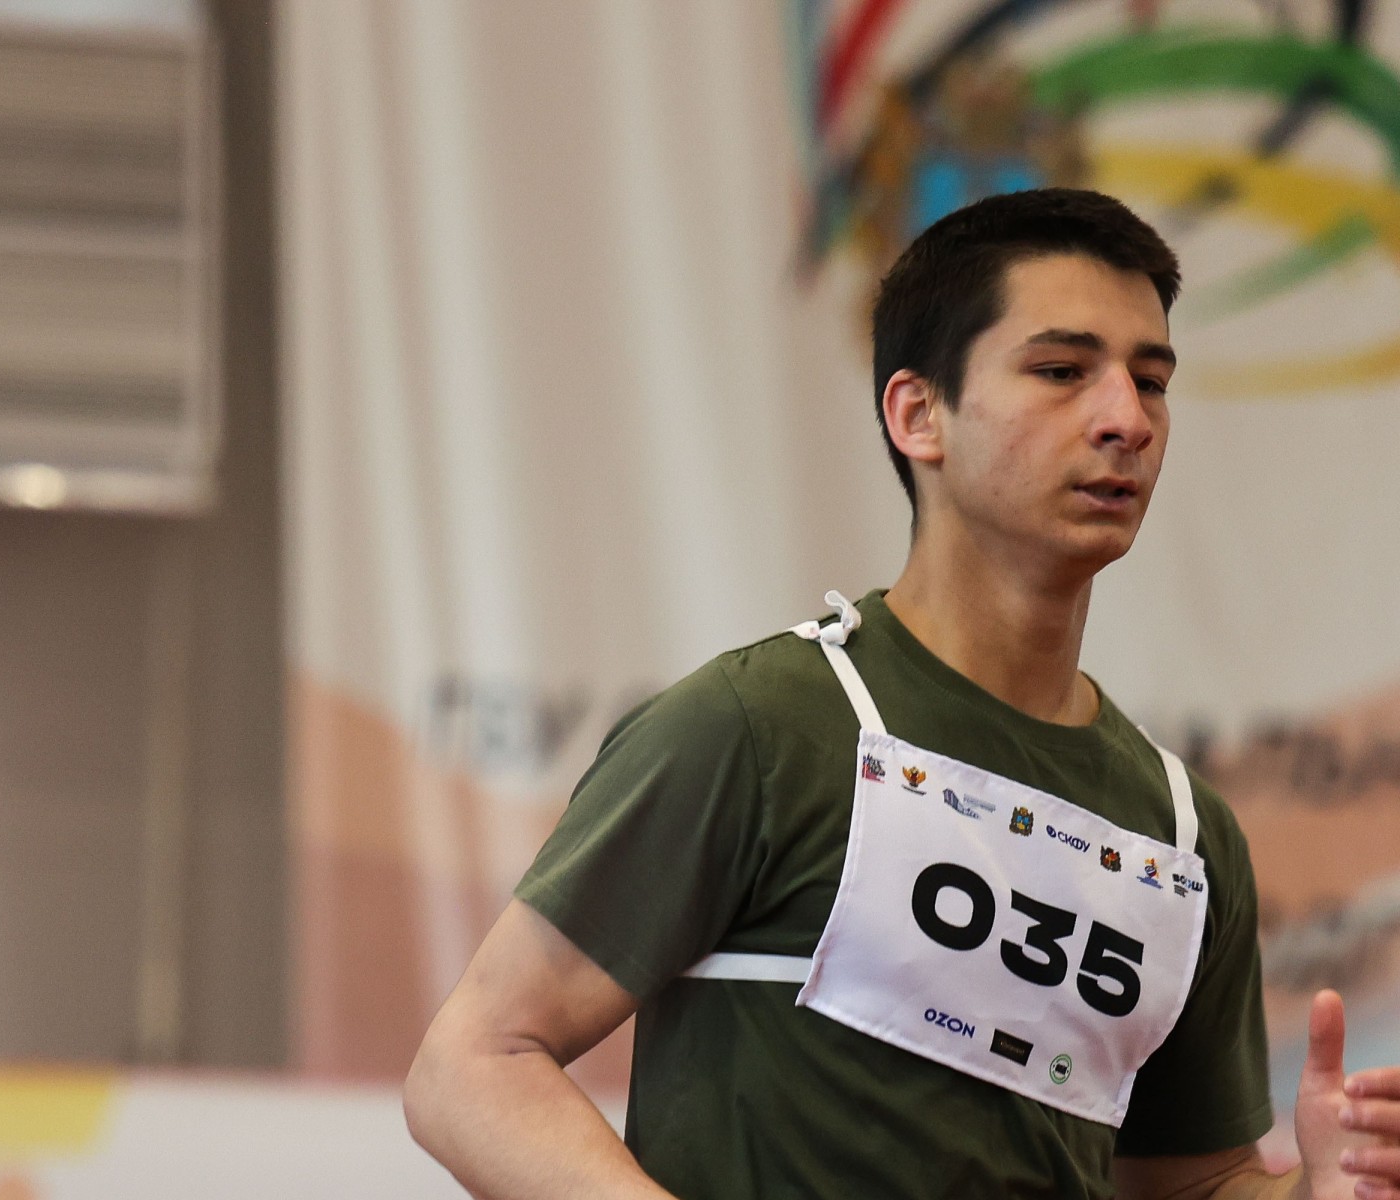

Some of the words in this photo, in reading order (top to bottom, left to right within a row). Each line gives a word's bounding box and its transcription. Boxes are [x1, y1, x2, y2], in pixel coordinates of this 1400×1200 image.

[1058, 831, 1091, 853] СКФУ
[911, 862, 1145, 1018] 035
[924, 1008, 976, 1038] OZON
